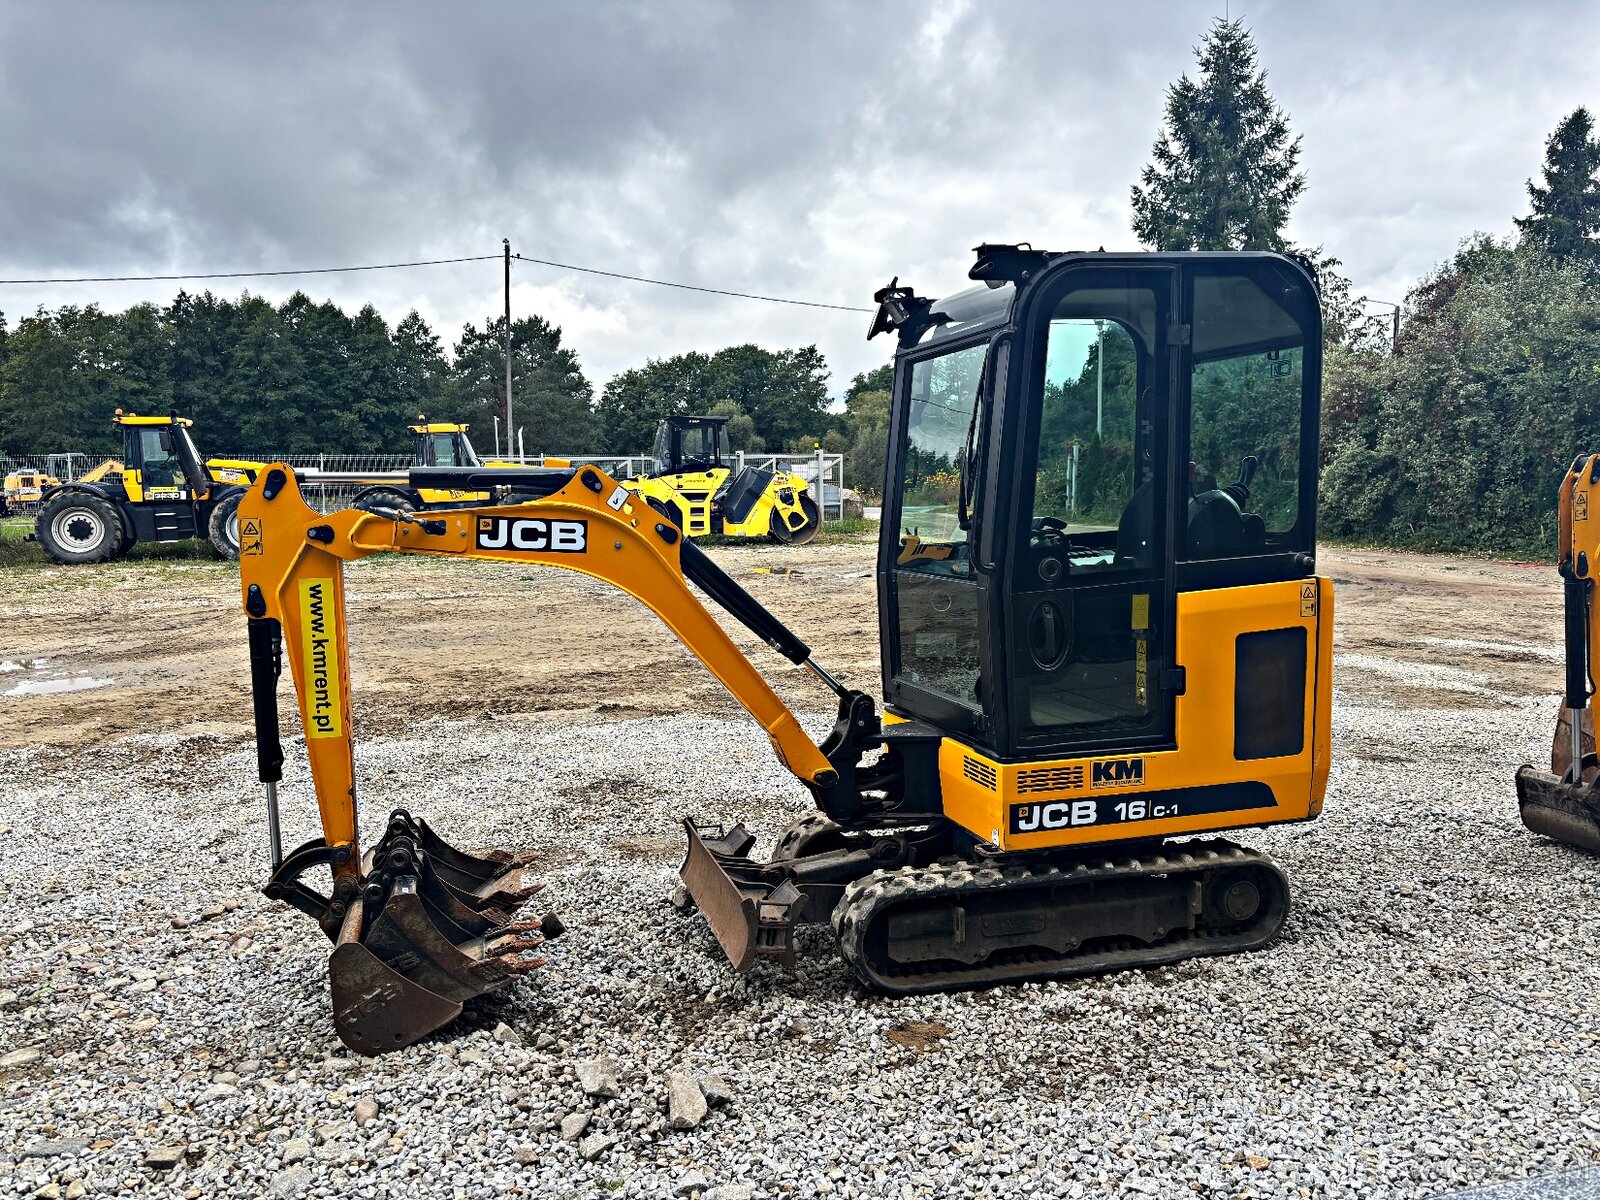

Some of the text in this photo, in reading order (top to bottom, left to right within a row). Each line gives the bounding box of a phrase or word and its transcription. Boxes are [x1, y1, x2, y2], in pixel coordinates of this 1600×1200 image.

[479, 519, 585, 550] JCB
[309, 583, 334, 732] www.kmrent.pl
[1093, 760, 1142, 782] KM
[1018, 801, 1098, 830] JCB
[1114, 801, 1146, 820] 16
